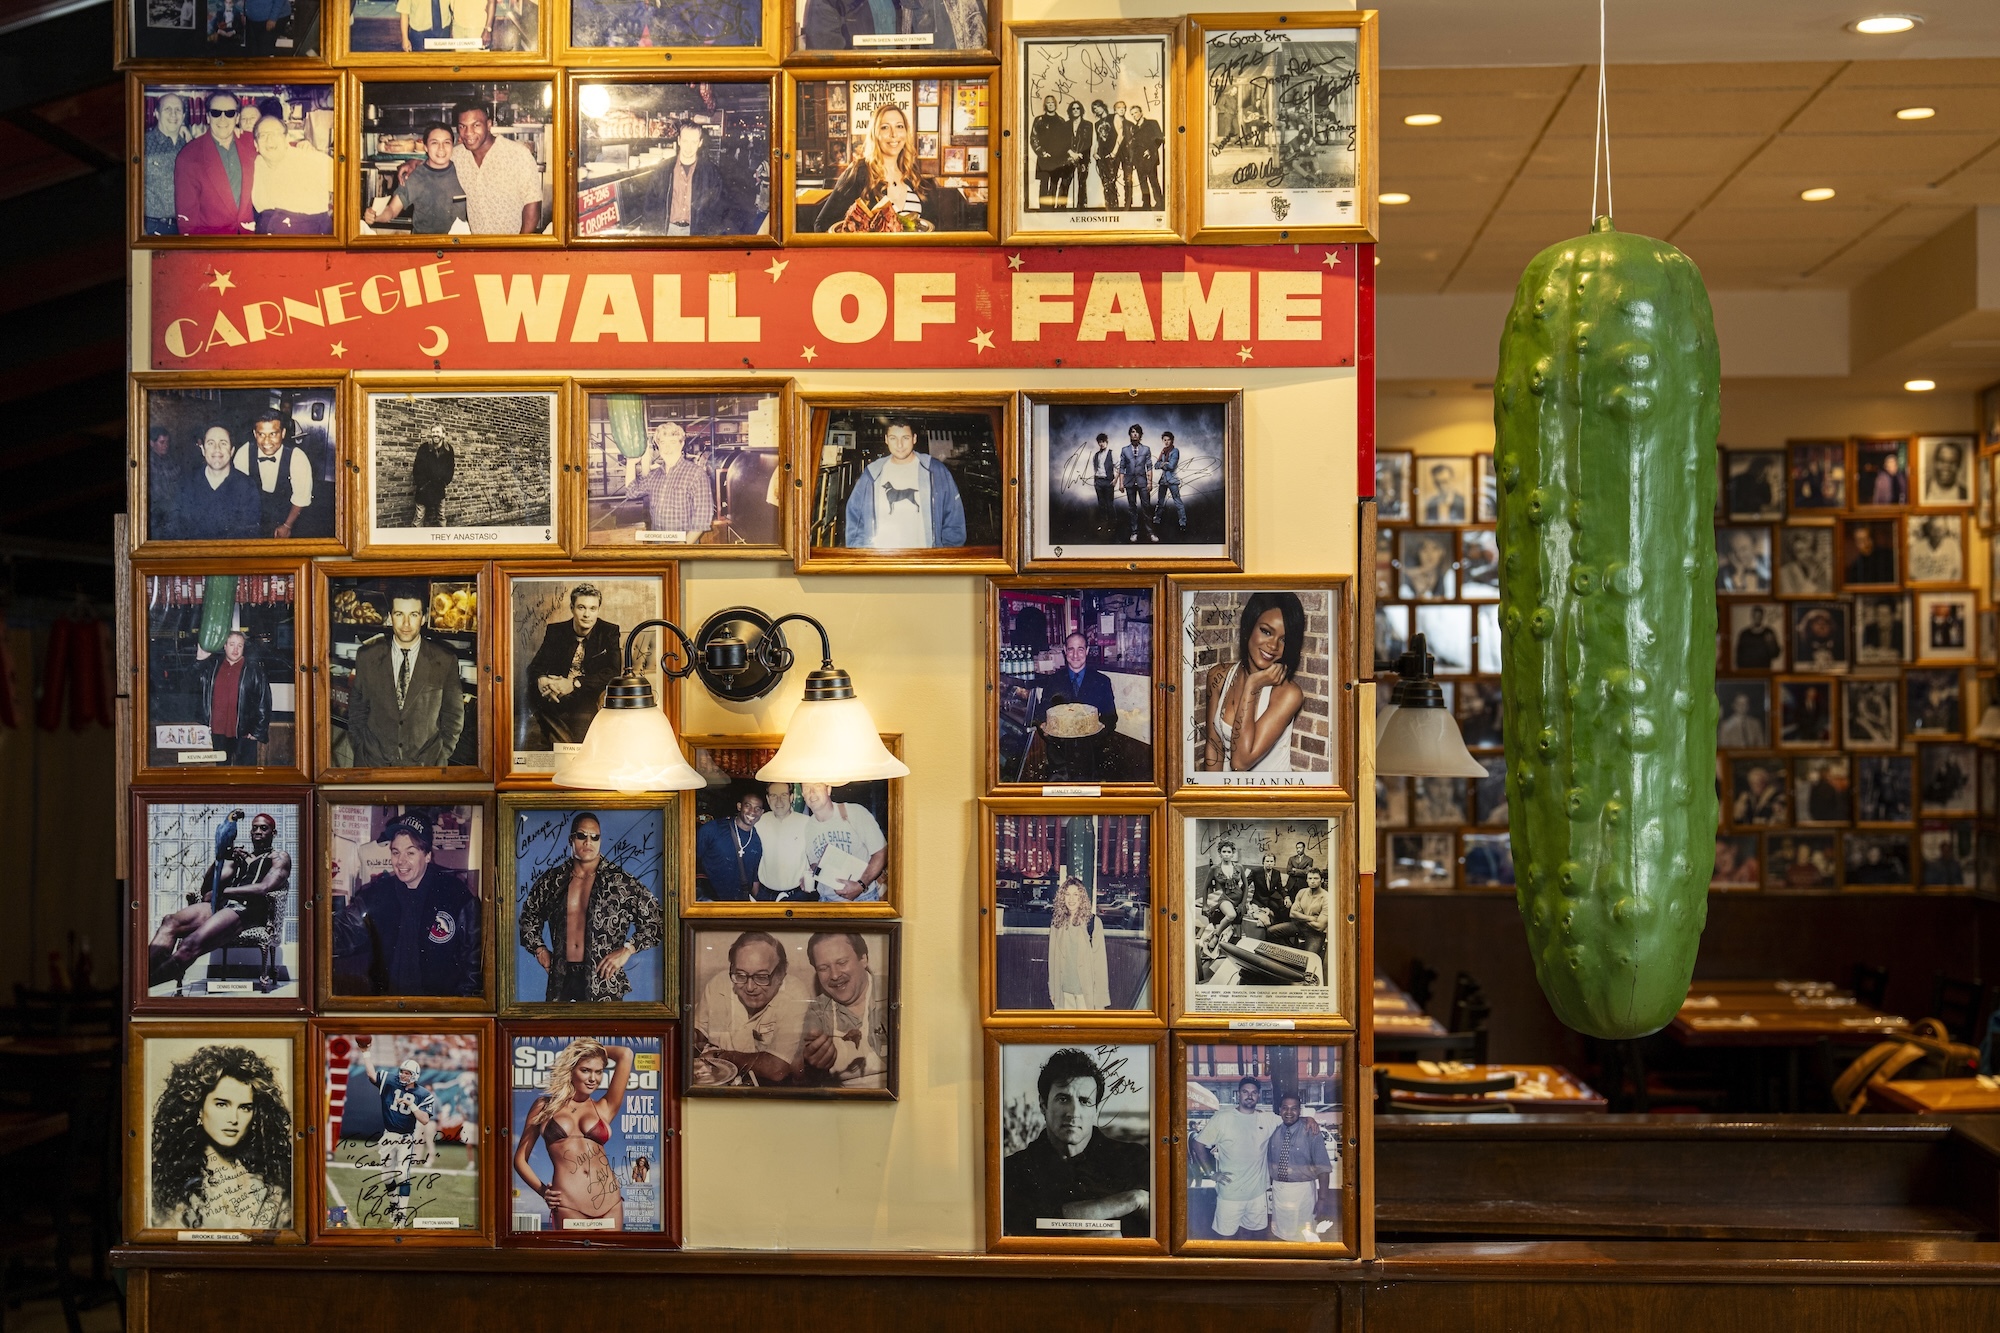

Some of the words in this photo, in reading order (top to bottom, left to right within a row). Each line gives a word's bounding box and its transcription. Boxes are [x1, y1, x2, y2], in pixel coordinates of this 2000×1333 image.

[853, 83, 911, 93] SKYSCRAPERS
[869, 93, 877, 102] IN
[880, 92, 896, 102] NYC
[856, 102, 872, 111] ARE
[898, 101, 910, 111] OF
[164, 260, 460, 358] CARNEGIE
[474, 273, 760, 343] WALL
[811, 271, 956, 343] OF
[1011, 271, 1323, 342] FAME
[431, 533, 451, 541] TREY
[453, 533, 498, 541] ANASTASIO
[818, 833, 828, 845] LA
[828, 831, 852, 844] SALLE
[626, 1096, 655, 1114] KATE
[621, 1114, 659, 1134] UPTON
